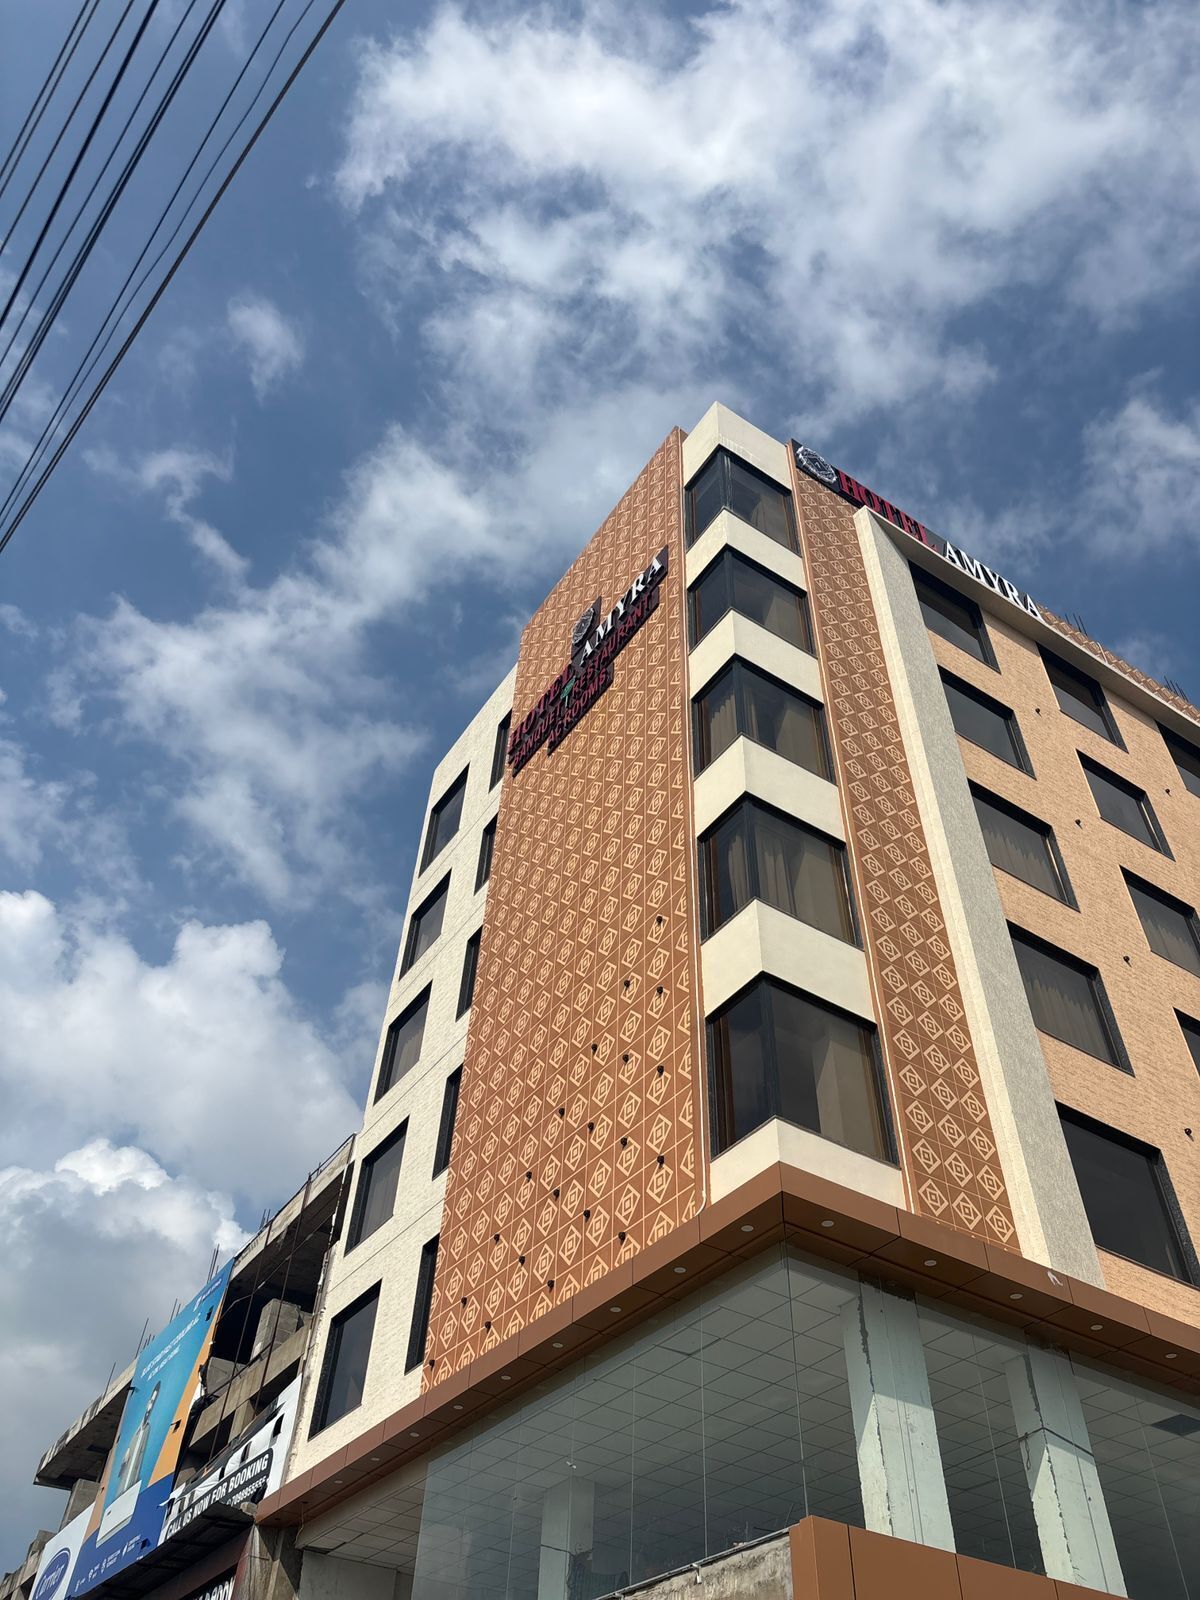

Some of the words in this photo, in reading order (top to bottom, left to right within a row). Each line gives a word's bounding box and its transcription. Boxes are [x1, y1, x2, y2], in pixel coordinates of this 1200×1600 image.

[836, 468, 940, 553] HOTEL
[944, 540, 1045, 624] AMYRA
[508, 664, 574, 755] HOTEL
[580, 556, 663, 668] AMYRA
[513, 702, 562, 766] BANQUET
[571, 591, 651, 695] RESTAURANT
[563, 667, 606, 730] ROOMS
[166, 1516, 182, 1540] CALL
[182, 1508, 193, 1527] US
[192, 1494, 212, 1521] NOW
[211, 1481, 228, 1504] FOR
[227, 1453, 269, 1493] BOOKING
